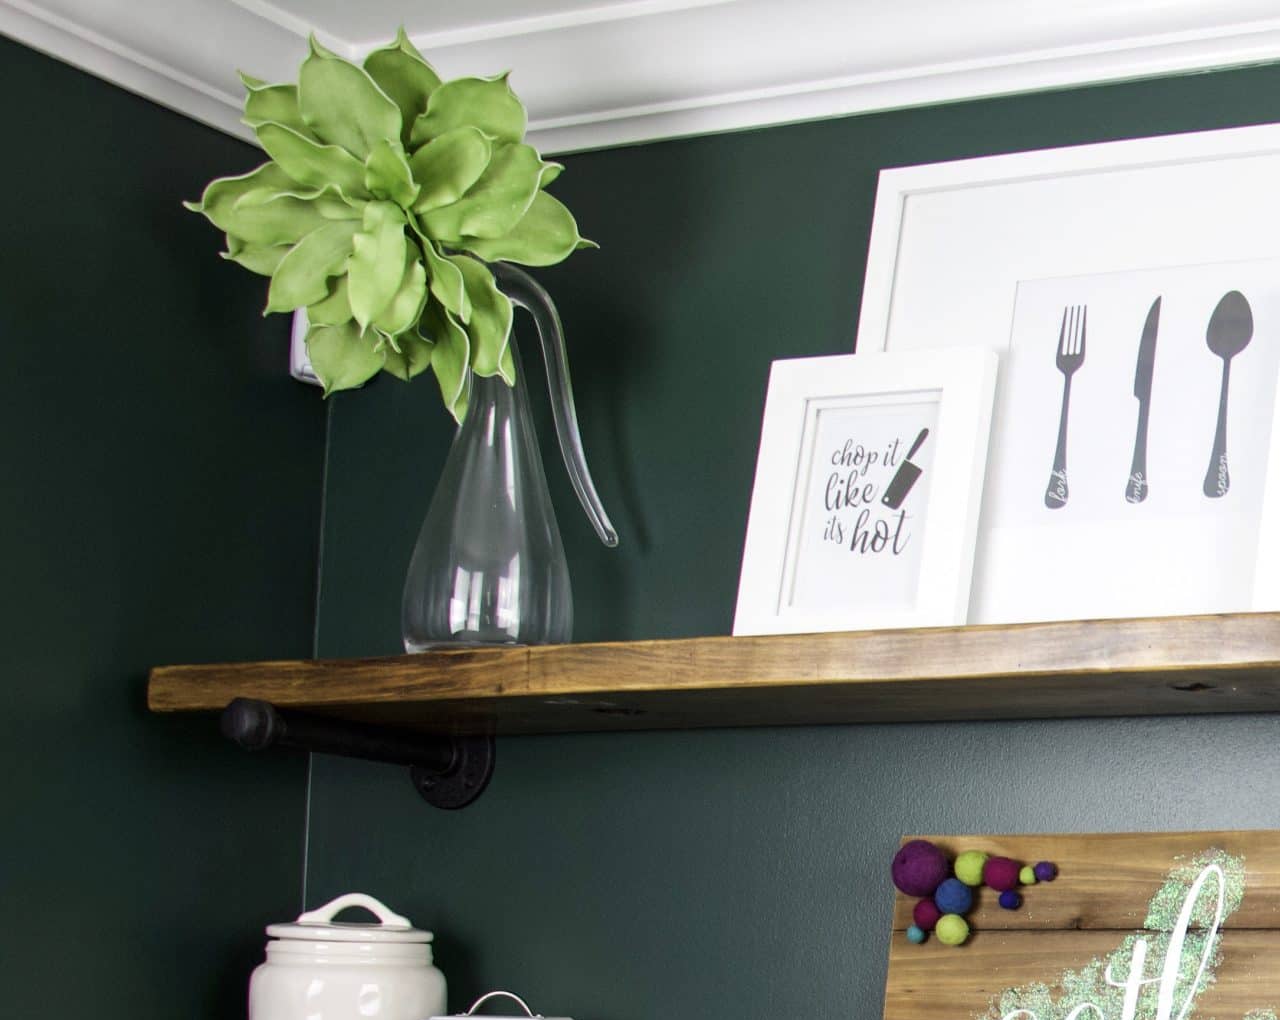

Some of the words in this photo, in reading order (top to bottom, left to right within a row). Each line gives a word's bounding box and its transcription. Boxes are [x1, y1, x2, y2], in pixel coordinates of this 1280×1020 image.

[831, 438, 879, 476] chop
[883, 437, 903, 467] it
[824, 469, 879, 511] like
[850, 508, 914, 555] hot
